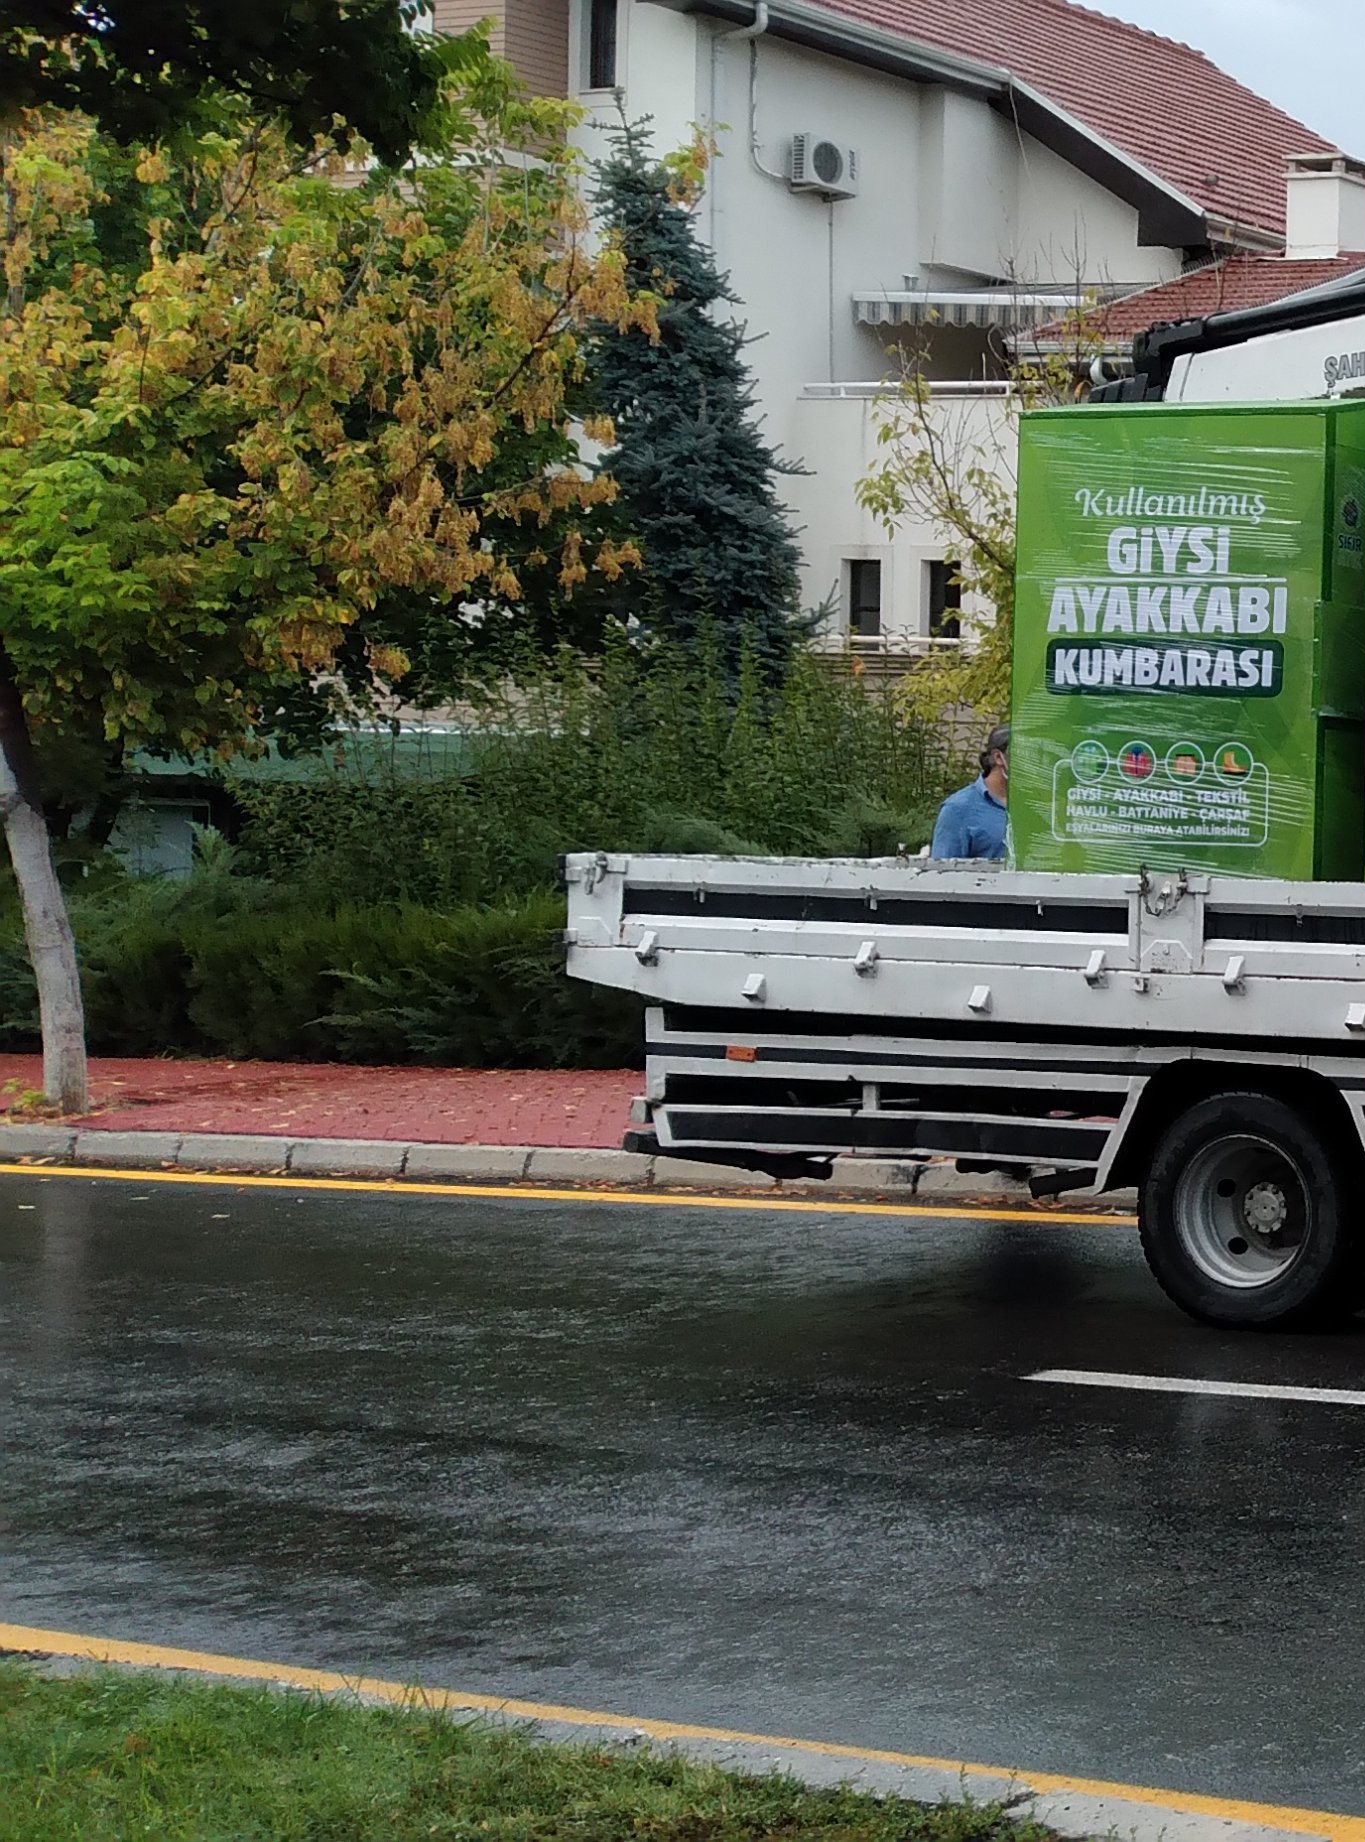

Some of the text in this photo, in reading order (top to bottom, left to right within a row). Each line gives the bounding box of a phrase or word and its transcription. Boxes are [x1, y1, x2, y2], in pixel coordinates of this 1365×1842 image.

[1074, 486, 1266, 525] Kullanılmış
[1047, 586, 1288, 634] AYAKKABI
[1054, 648, 1273, 687] KUMBARASI
[1066, 805, 1108, 818] HAVLU
